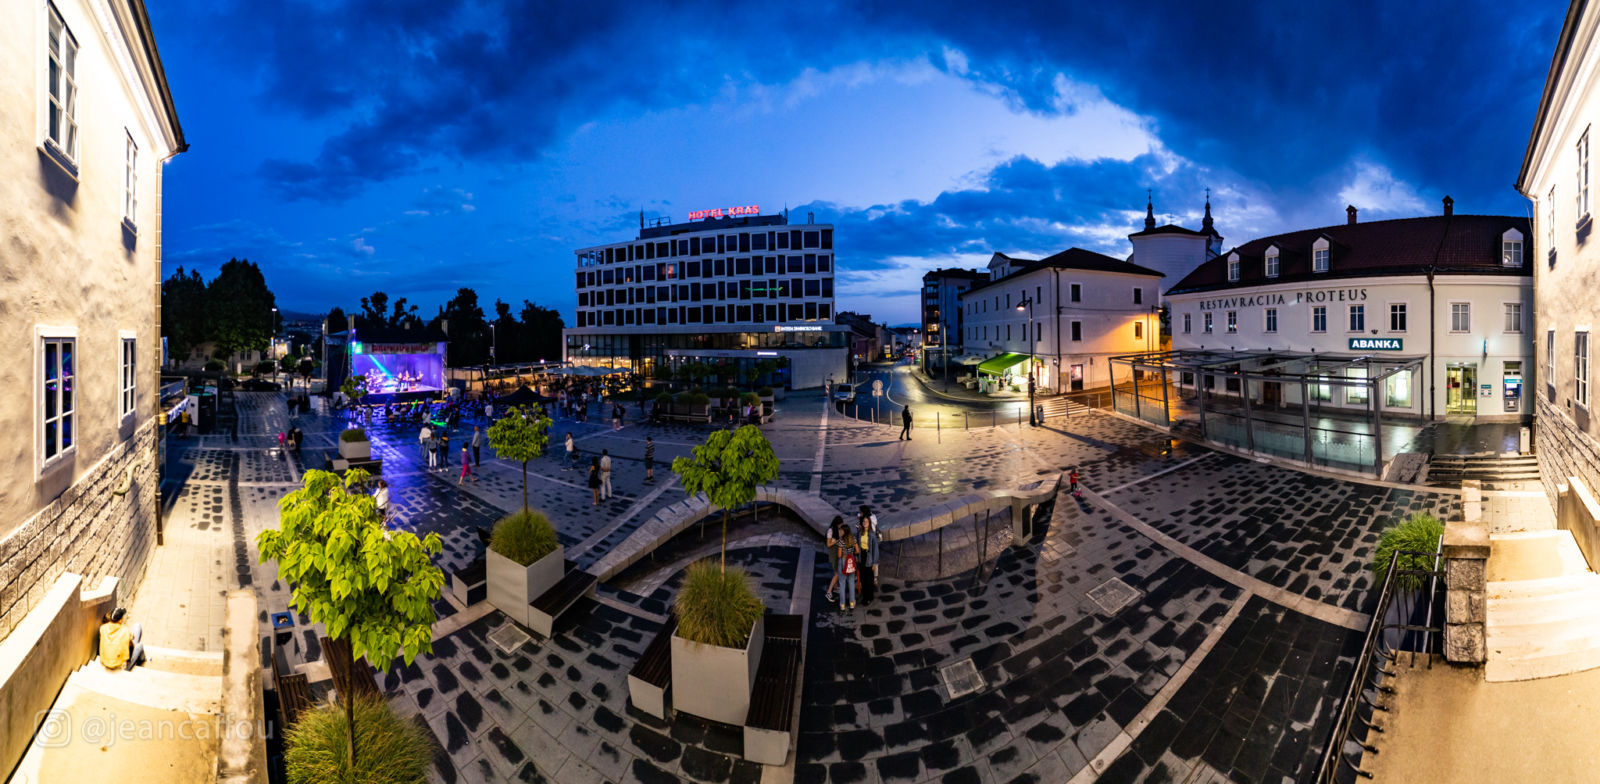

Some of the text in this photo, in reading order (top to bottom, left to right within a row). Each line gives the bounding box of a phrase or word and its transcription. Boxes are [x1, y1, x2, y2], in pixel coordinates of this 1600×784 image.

[688, 205, 759, 220] HOTEL KRAS
[1200, 288, 1368, 310] RESTAVRACIJA PROTEUS
[1351, 340, 1400, 349] ABANKA
